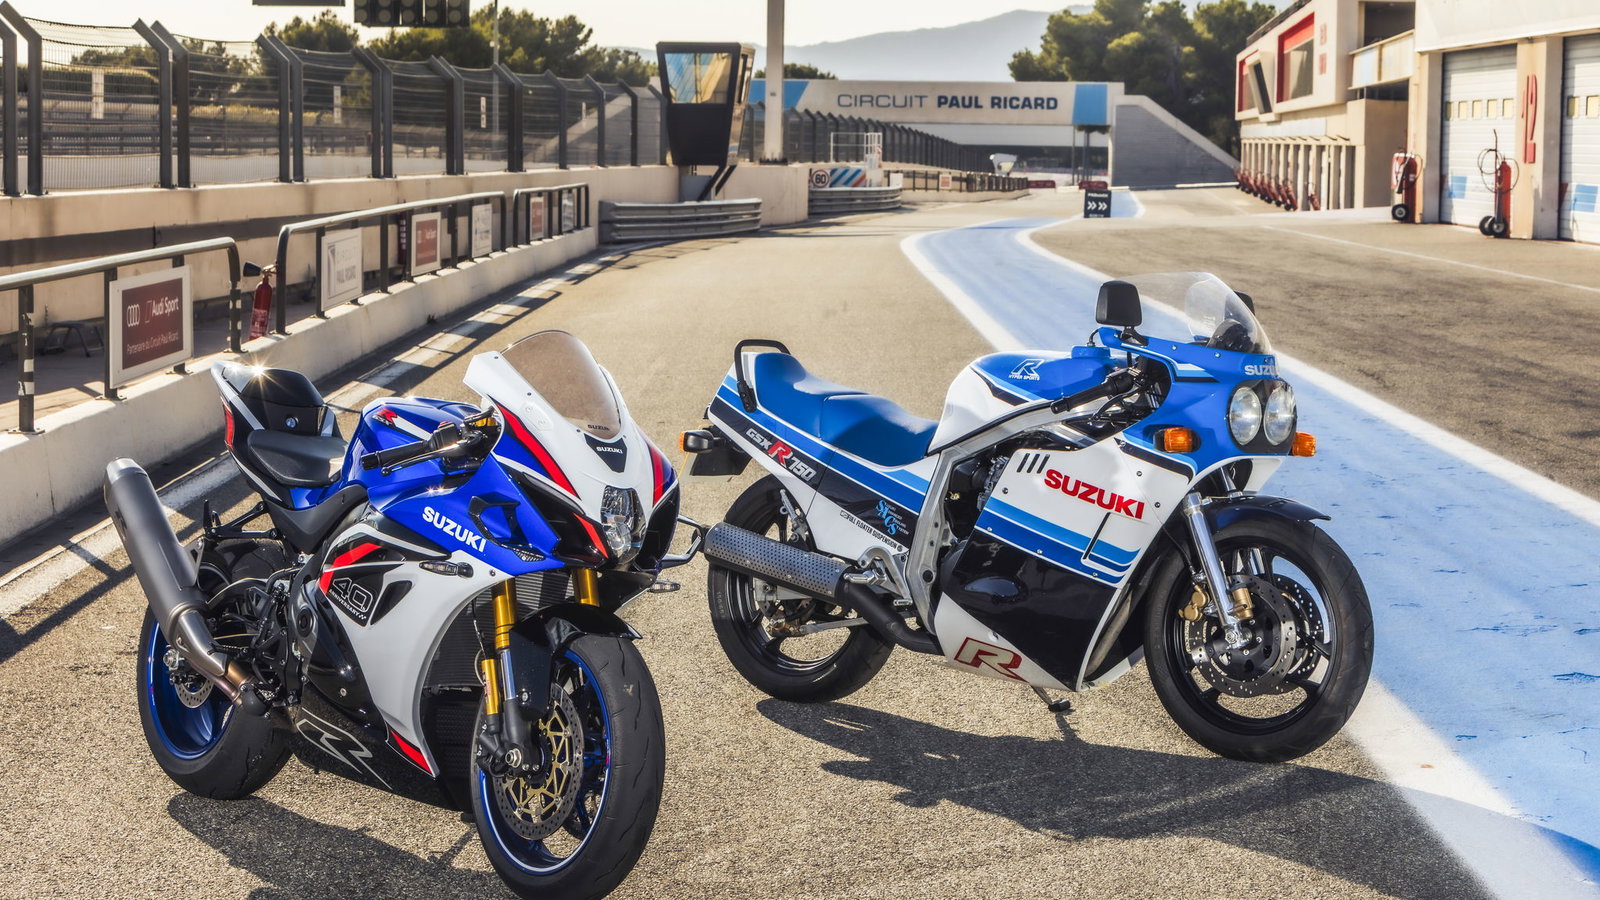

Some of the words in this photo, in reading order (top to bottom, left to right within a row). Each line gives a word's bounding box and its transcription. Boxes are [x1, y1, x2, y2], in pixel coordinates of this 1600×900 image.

[837, 94, 928, 108] CIRCUIT
[937, 95, 983, 109] PAUL
[990, 96, 1058, 110] RICARD
[815, 174, 826, 185] 60
[152, 297, 164, 316] Audi
[164, 296, 179, 317] Sport
[1244, 364, 1276, 376] SUZU
[596, 446, 623, 454] SUZUKI
[1044, 469, 1145, 520] SUZUKI
[422, 506, 487, 552] SUZUKI
[847, 513, 856, 525] FULL
[856, 518, 873, 535] FLOATER
[872, 529, 898, 550] SUSPENSION
[328, 588, 360, 617] ANNIVERSARY
[953, 636, 1030, 684] R
